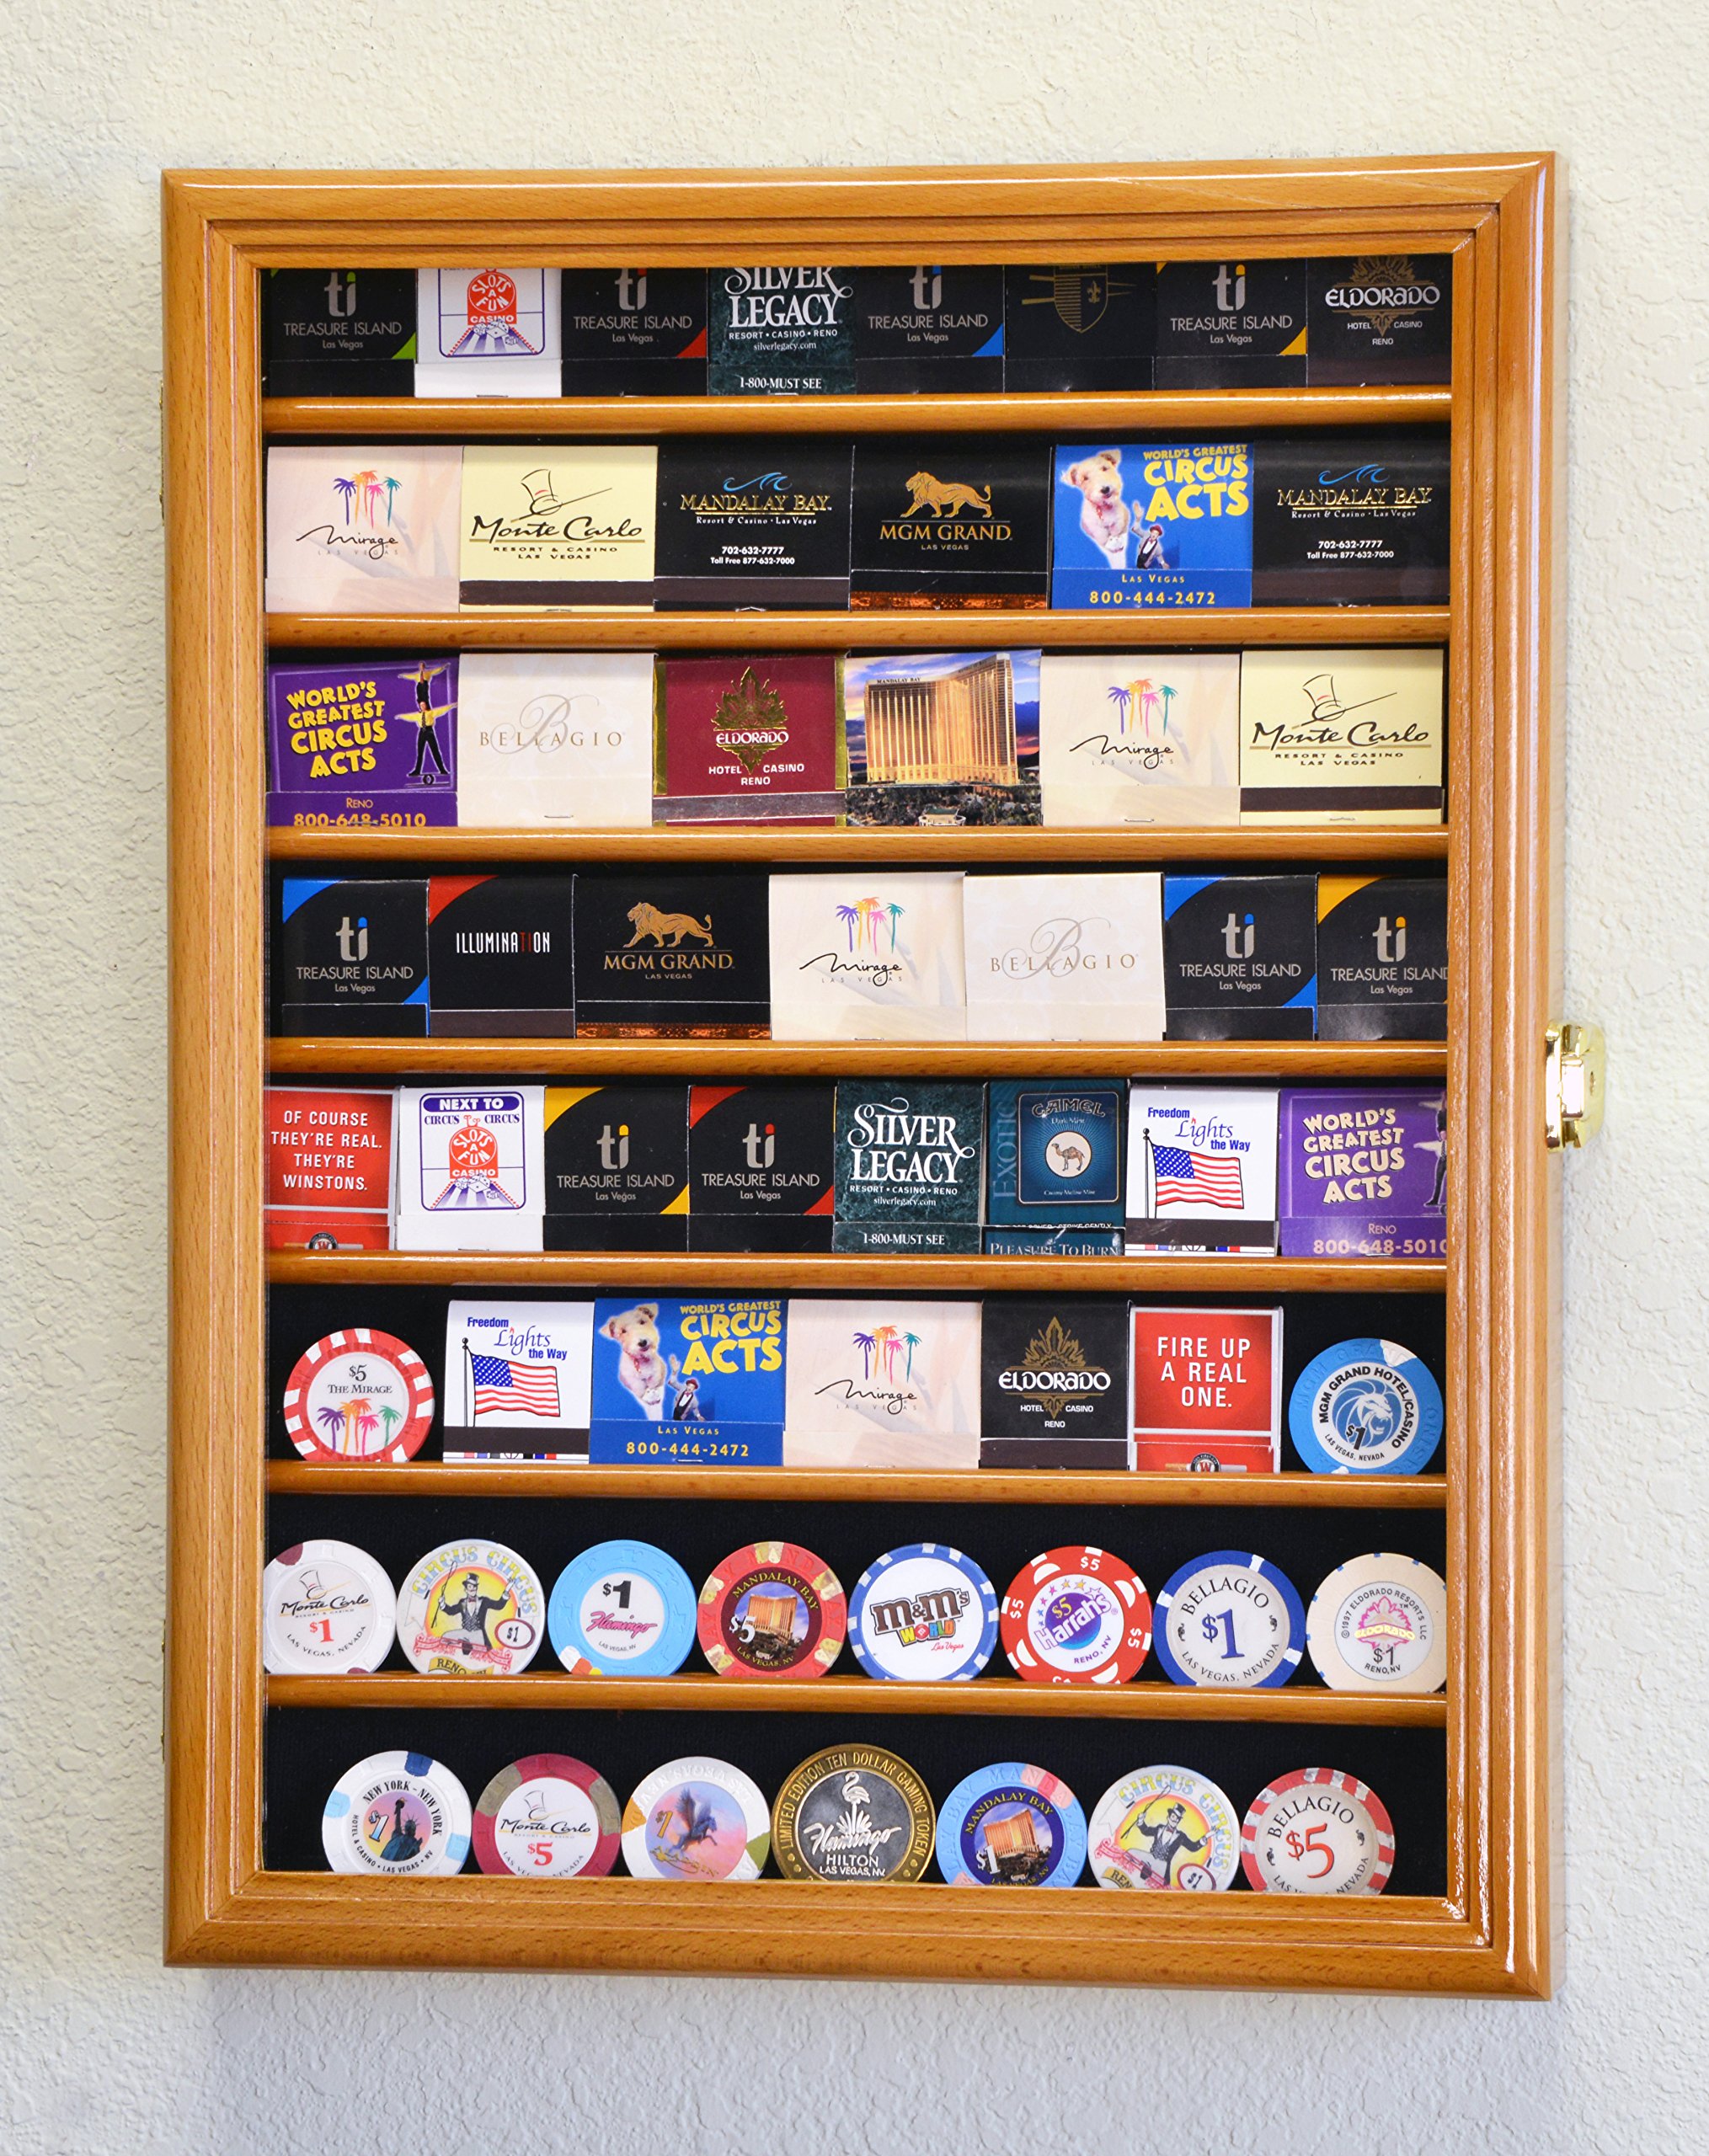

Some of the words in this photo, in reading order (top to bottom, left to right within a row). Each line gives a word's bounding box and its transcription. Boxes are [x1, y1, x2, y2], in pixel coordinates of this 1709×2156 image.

[284, 322, 348, 336] TREASURE
[354, 321, 402, 335] ISLAND
[323, 340, 337, 349] Las
[339, 340, 363, 350] Vegas
[753, 341, 816, 351] silverlegacy.com
[1194, 445, 1247, 457] GREATEST
[1144, 455, 1248, 487] CIRCUS
[681, 494, 788, 511] MANDALAY
[793, 494, 830, 510] BAY
[1145, 481, 1249, 522] ACTS
[470, 515, 559, 544] Monte
[563, 516, 642, 542] Carlo
[697, 516, 724, 525] Resort
[738, 516, 767, 525] Casino
[792, 517, 816, 526] Vegas
[296, 526, 398, 559] Mirage
[879, 526, 931, 540] MGM
[937, 526, 1011, 540] GRAND
[721, 547, 784, 555] 702-632-7777
[743, 557, 794, 565] 877-632-7000
[1090, 591, 1215, 605] 800-444-2472
[287, 700, 385, 730] GREATEST
[291, 720, 387, 755] CIRCUS
[1252, 722, 1343, 750] Monte
[1347, 722, 1429, 746] Carlo
[310, 747, 377, 779] ACTS
[708, 766, 741, 775] HOTEL
[763, 764, 804, 773] CASINO
[336, 916, 368, 961] ti
[456, 931, 550, 953] ILLUMINATION
[604, 955, 654, 970] MGM
[660, 954, 733, 969] GRAND
[799, 953, 902, 987] Mirage
[991, 953, 1135, 973] BELLAGIO
[296, 967, 360, 979] TREASURE
[366, 966, 414, 979] ISLAND
[335, 984, 348, 992] Las
[350, 984, 375, 994] Vegas
[1370, 985, 1384, 994] Las
[1386, 985, 1413, 995] Vegas
[440, 1098, 479, 1110] NEXT
[483, 1097, 504, 1109] TO
[1032, 1098, 1105, 1118] CAMEL
[1148, 1107, 1189, 1118] Freedom
[284, 1111, 302, 1123] OF
[309, 1111, 368, 1127] COURSE
[425, 1115, 459, 1125] CIRCUS
[484, 1113, 520, 1123] CIRCUS
[847, 1097, 975, 1159] SILVER
[341, 1134, 382, 1148] REAL.
[453, 1129, 493, 1148] SLOTS
[1175, 1116, 1233, 1147] Lights
[1210, 1139, 1226, 1150] the
[1229, 1139, 1250, 1153] Way
[458, 1151, 490, 1164] FUN
[851, 1150, 960, 1183] LEGACY
[284, 1175, 367, 1191] WINSTONS.
[452, 1169, 496, 1177] CASINO
[863, 1233, 923, 1245] 1-800-MUST
[926, 1234, 945, 1245] SEE
[1158, 1337, 1208, 1358] FIRE
[1221, 1338, 1251, 1358] UP
[349, 1364, 367, 1381] $5
[1161, 1363, 1175, 1381] A
[1189, 1363, 1247, 1383] REAL
[1182, 1387, 1232, 1408] ONE.
[1320, 1392, 1332, 1423] MGM
[1329, 1366, 1370, 1390] GRAND
[1374, 1367, 1414, 1449] HOTEL/CASINO
[1325, 1433, 1334, 1446] LAS
[1335, 1444, 1356, 1460] VEGAS,
[1359, 1452, 1385, 1461] NEVADA
[1346, 1425, 1366, 1450] $1
[626, 1443, 749, 1456] 800-444-2472
[1080, 1556, 1100, 1571] $5
[411, 1547, 478, 1595] CIRCUS
[486, 1548, 537, 1615] CIRCUS
[1181, 1577, 1269, 1616] BELLAGIO
[1350, 1588, 1392, 1609] ELDORADO
[1394, 1591, 1424, 1620] RESORTS
[310, 1619, 334, 1643] $1
[507, 1626, 520, 1641] $1
[586, 1611, 658, 1638] Flamingo
[729, 1614, 756, 1643] $5
[1202, 1609, 1245, 1660] $1
[736, 1646, 750, 1659] LAS
[751, 1656, 782, 1667] VEGAS,
[782, 1656, 794, 1665] NV
[932, 1641, 945, 1652] Las
[946, 1642, 964, 1652] Vegas
[1074, 1651, 1103, 1663] RENO,
[1102, 1635, 1111, 1649] NV
[1183, 1651, 1199, 1670] LAS
[1201, 1667, 1239, 1682] VEGAS,
[1243, 1643, 1279, 1678] NEVADA
[362, 1786, 382, 1805] NEW
[384, 1781, 409, 1793] YORK
[417, 1788, 435, 1809] NEW
[430, 1806, 443, 1837] YORK
[781, 1802, 795, 1849] LIMITED
[788, 1761, 825, 1801] EDITION
[825, 1753, 847, 1767] TEN
[853, 1753, 897, 1776] DOLLAR
[898, 1771, 921, 1813] GAMING
[911, 1818, 930, 1856] TOKEN
[965, 1791, 1027, 1834] MANDALAY
[1028, 1796, 1055, 1817] BAY
[368, 1811, 388, 1842] $1
[499, 1818, 548, 1833] Monte
[550, 1819, 591, 1833] Carlo
[804, 1822, 902, 1854] Flamingo
[356, 1845, 377, 1868] CASINO
[425, 1850, 433, 1861] NV
[527, 1842, 553, 1866] $5
[975, 1844, 1001, 1875] $1
[1285, 1822, 1334, 1878] $5
[398, 1861, 419, 1873] VEGAS
[820, 1865, 836, 1874] LAS
[840, 1866, 871, 1876] VEGAS,
[826, 1854, 879, 1867] HILTON
[1274, 1875, 1291, 1892] LAS
